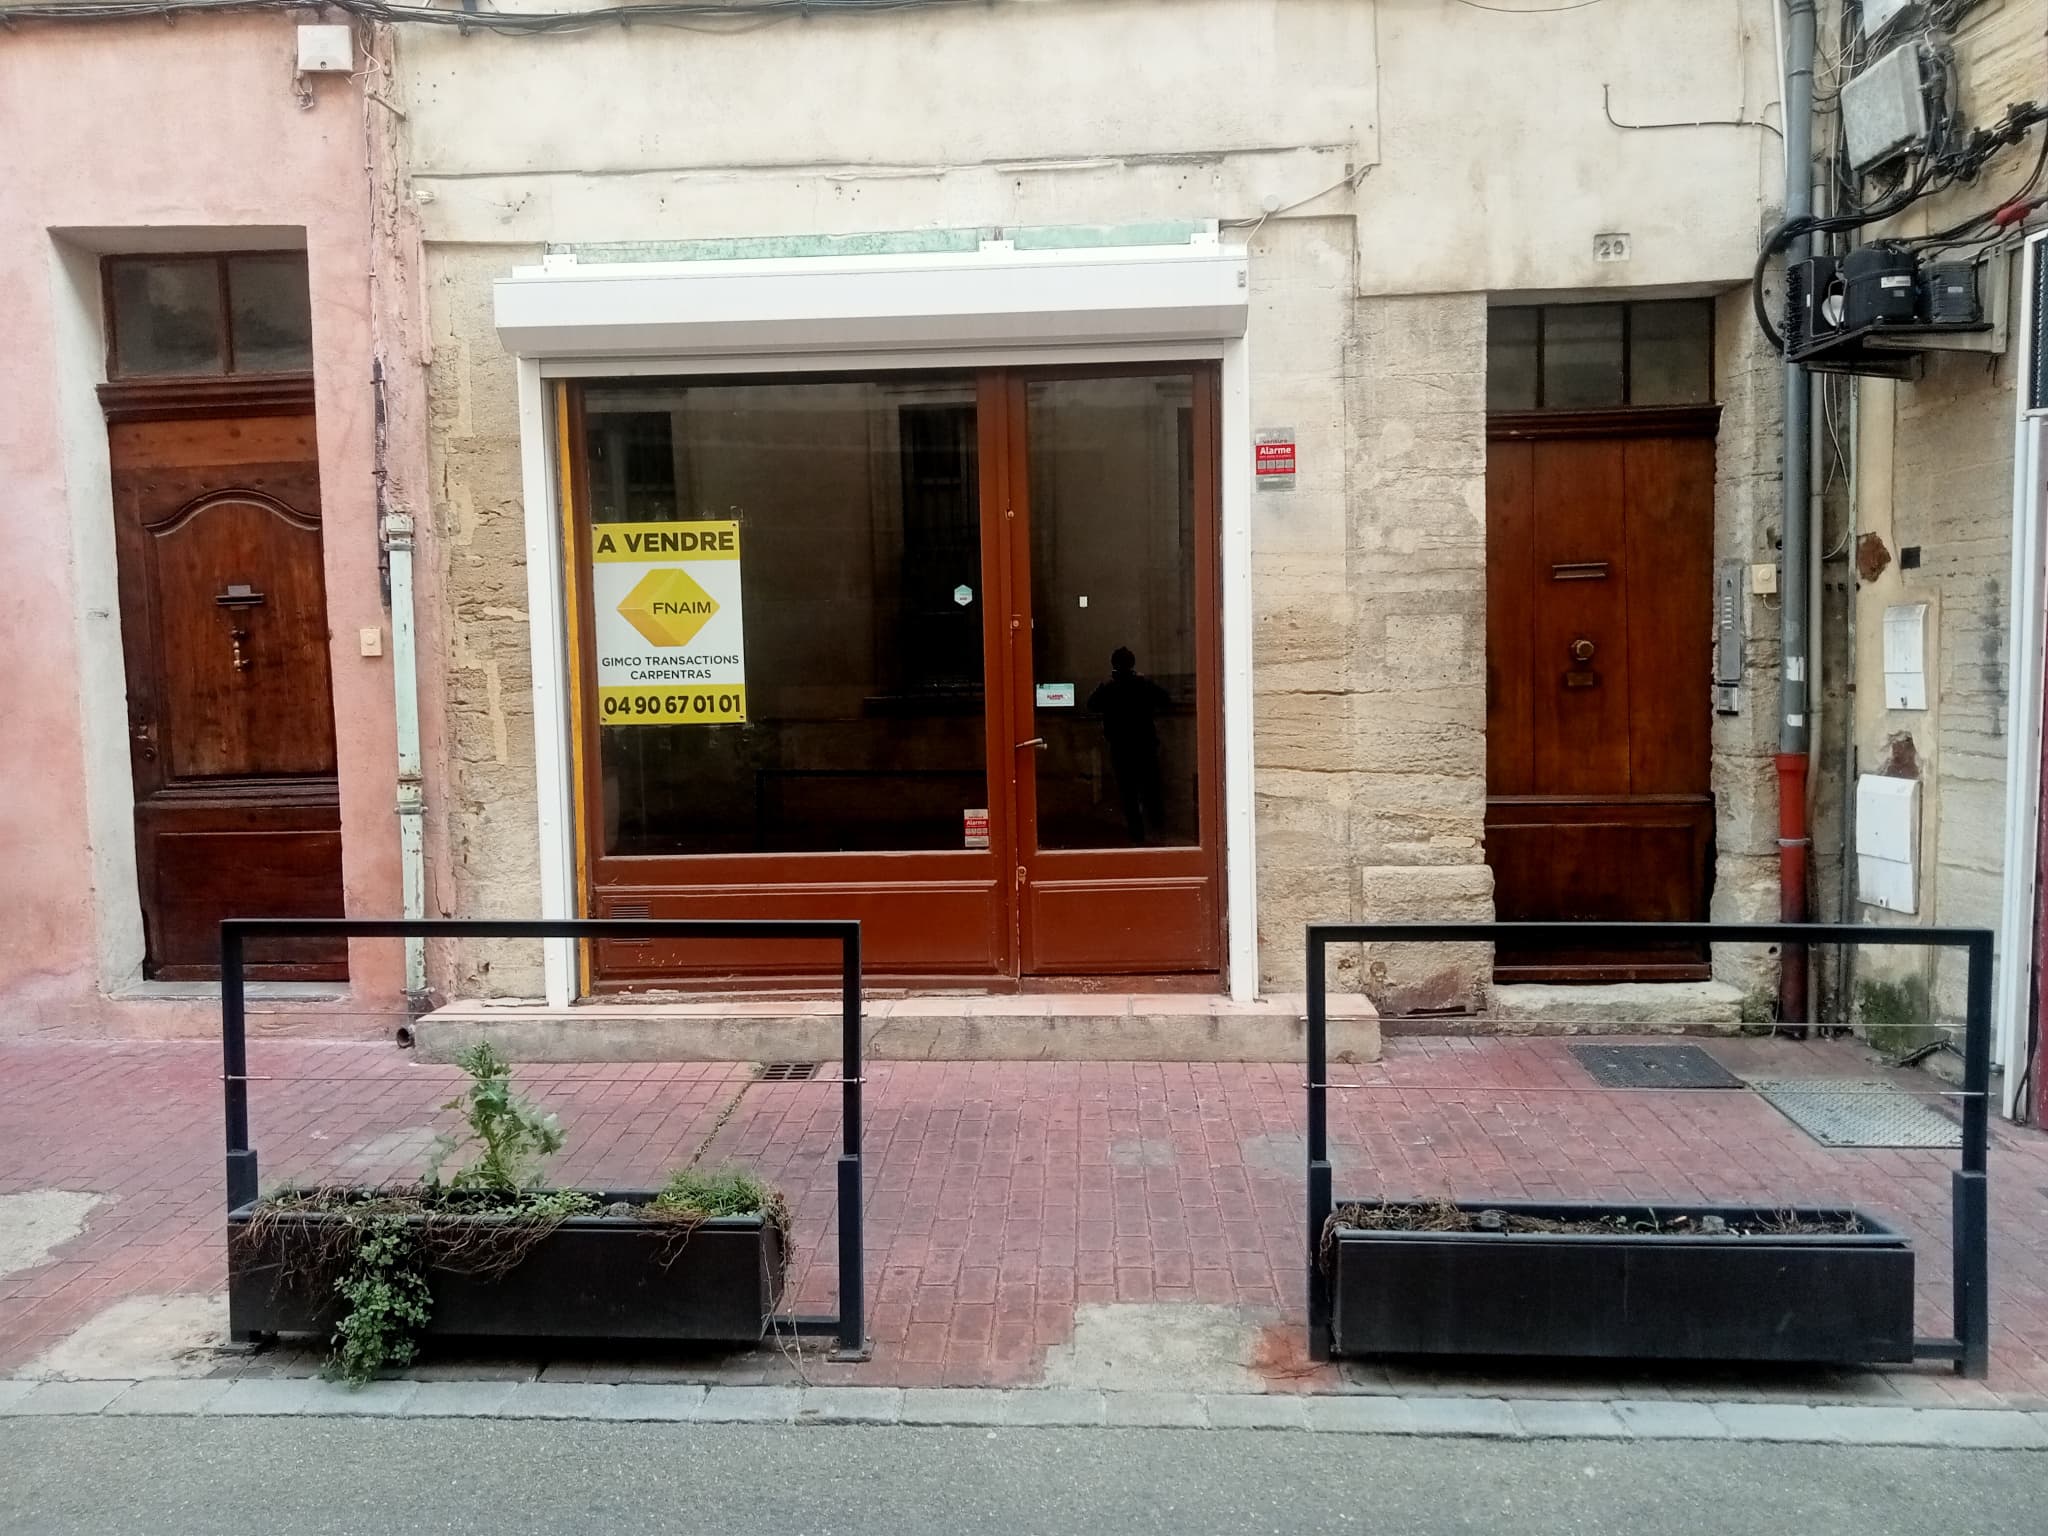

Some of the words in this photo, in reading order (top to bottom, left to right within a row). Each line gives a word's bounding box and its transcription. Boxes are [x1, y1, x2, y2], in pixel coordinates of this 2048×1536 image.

[1260, 446, 1292, 454] Alarme
[597, 534, 616, 553] A
[624, 531, 734, 553] VENDRE
[653, 601, 711, 615] FNAIM
[601, 657, 642, 667] GIMCO
[645, 655, 739, 666] TRANSACTIONS
[630, 669, 712, 680] CARPENTRAS
